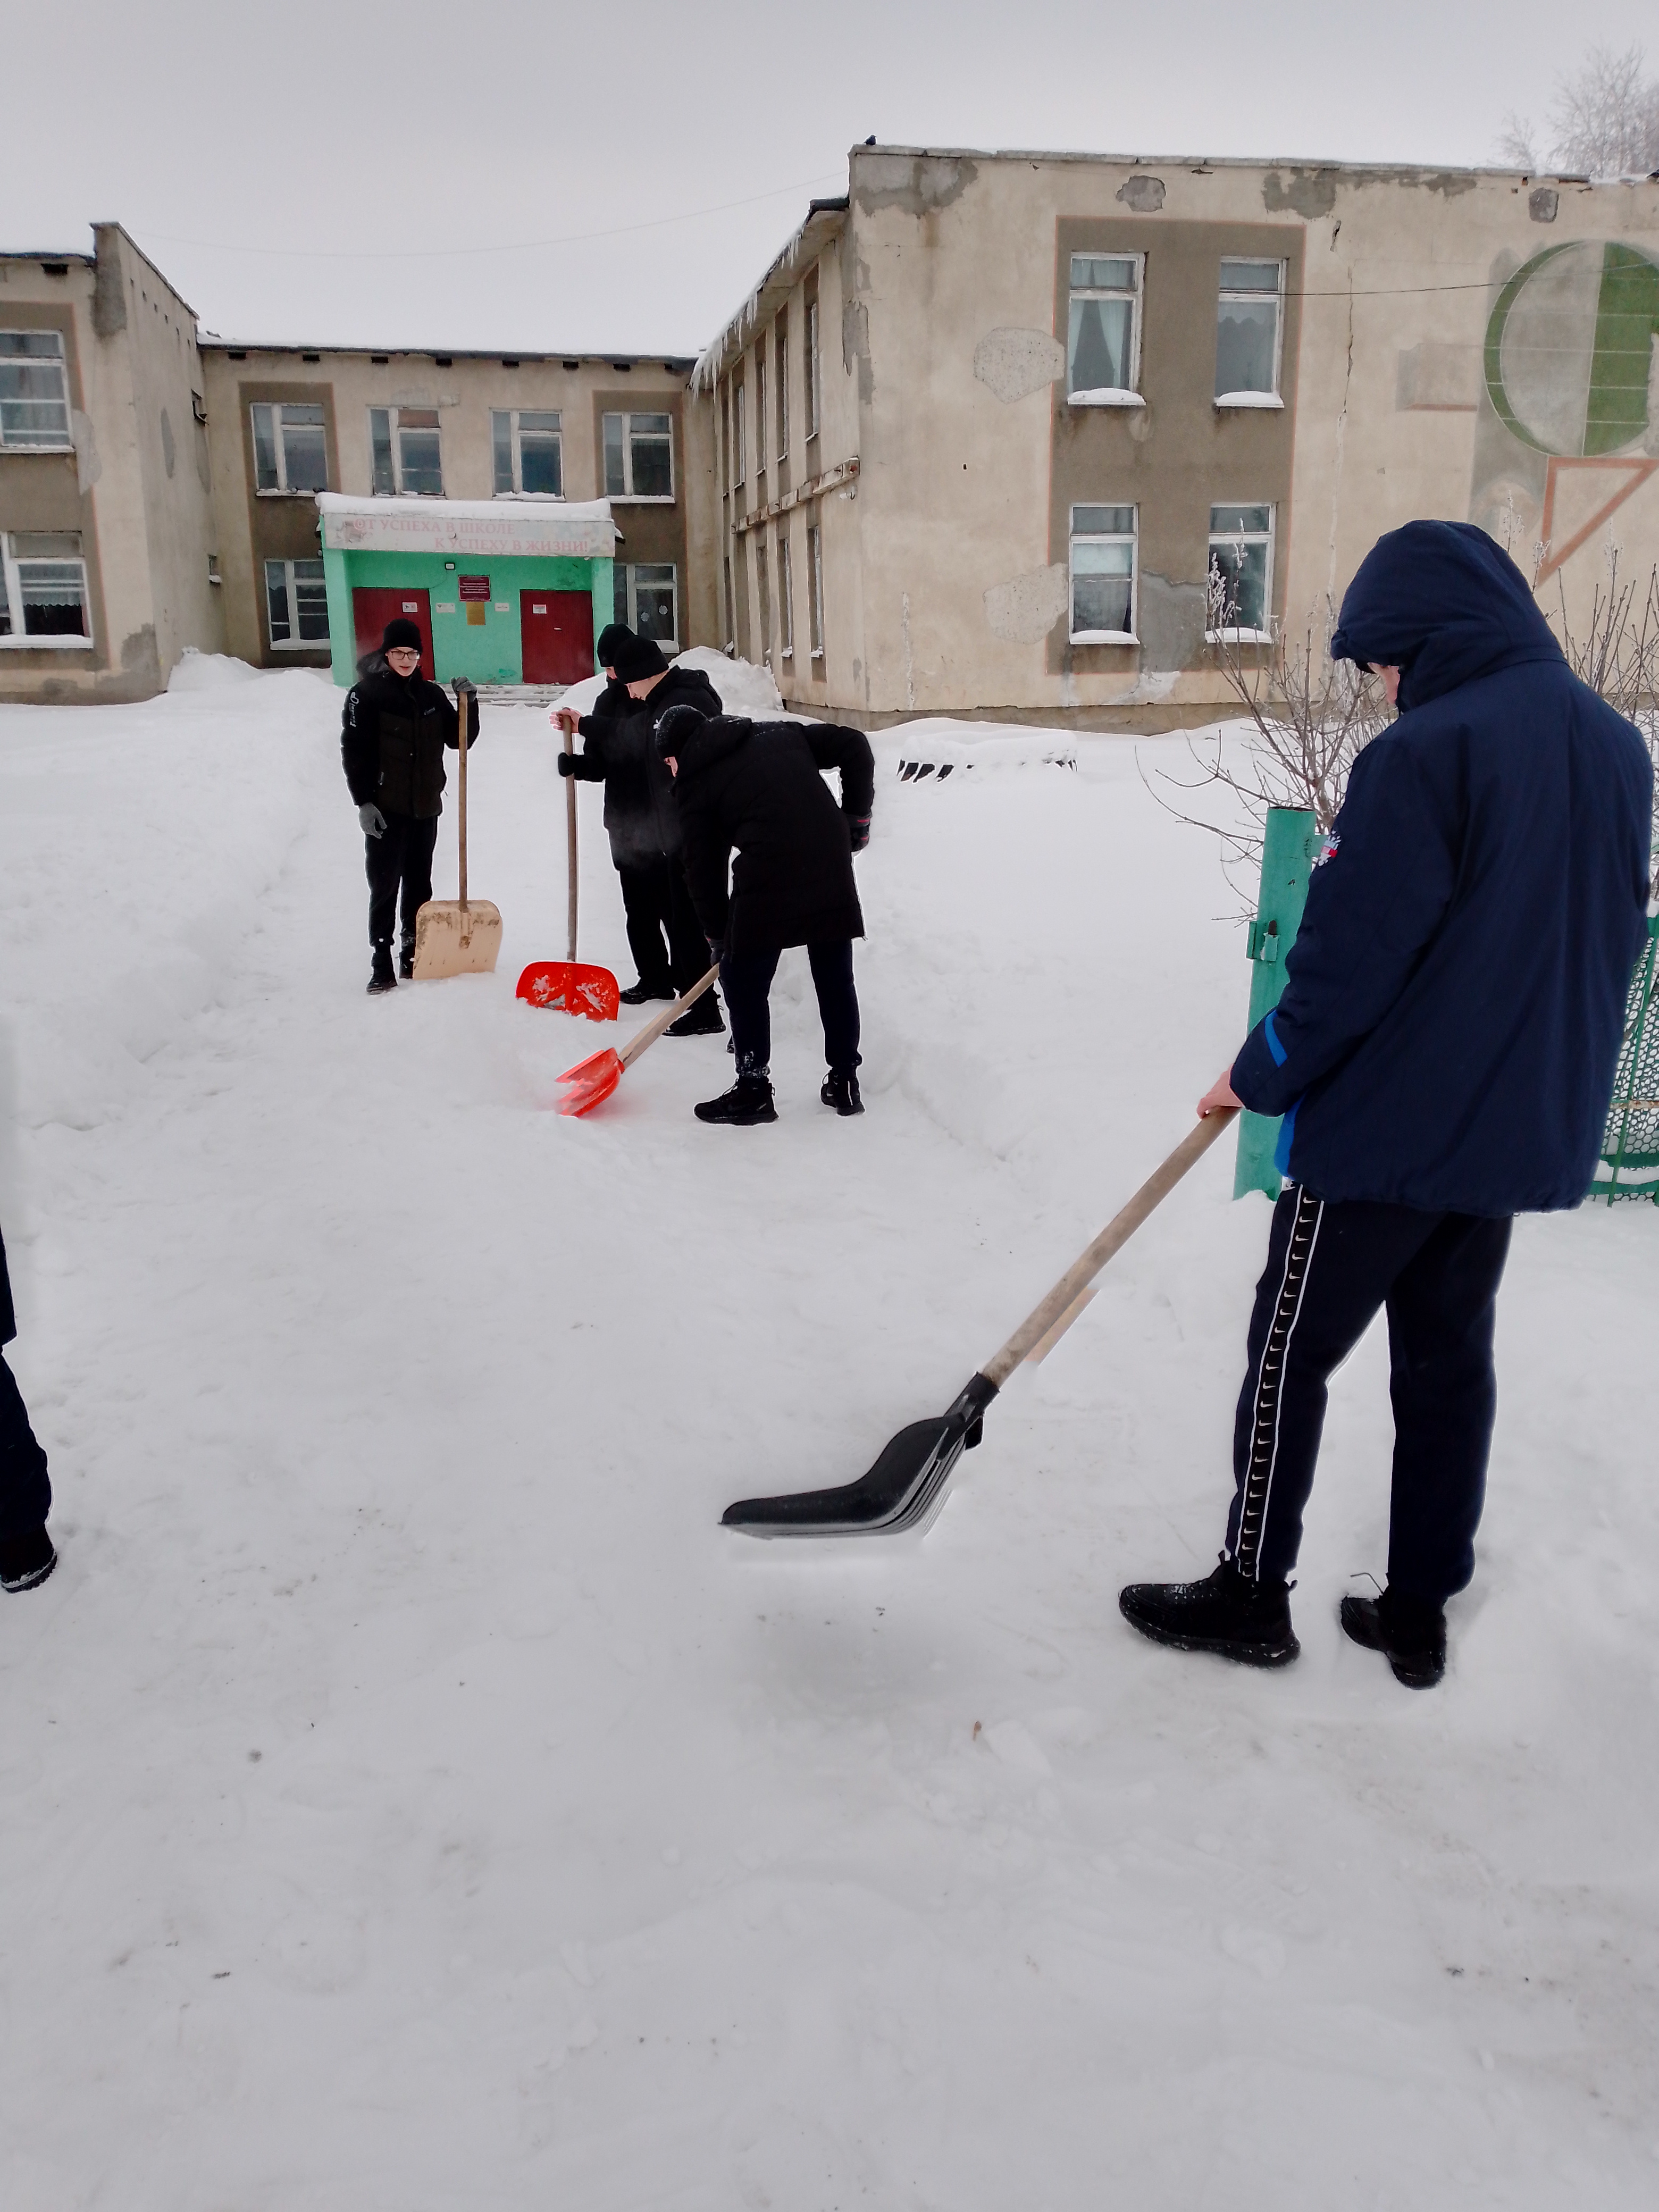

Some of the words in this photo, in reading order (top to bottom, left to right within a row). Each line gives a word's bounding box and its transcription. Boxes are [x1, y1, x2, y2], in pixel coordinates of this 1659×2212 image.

[380, 520, 441, 532] УСПЕХА
[446, 522, 455, 532] В
[460, 523, 515, 534] ШКОЛЕ
[435, 538, 445, 548] К
[450, 539, 507, 550] УСПЕХУ
[512, 540, 521, 550] В
[526, 541, 588, 552] ЖИЗНИ!
